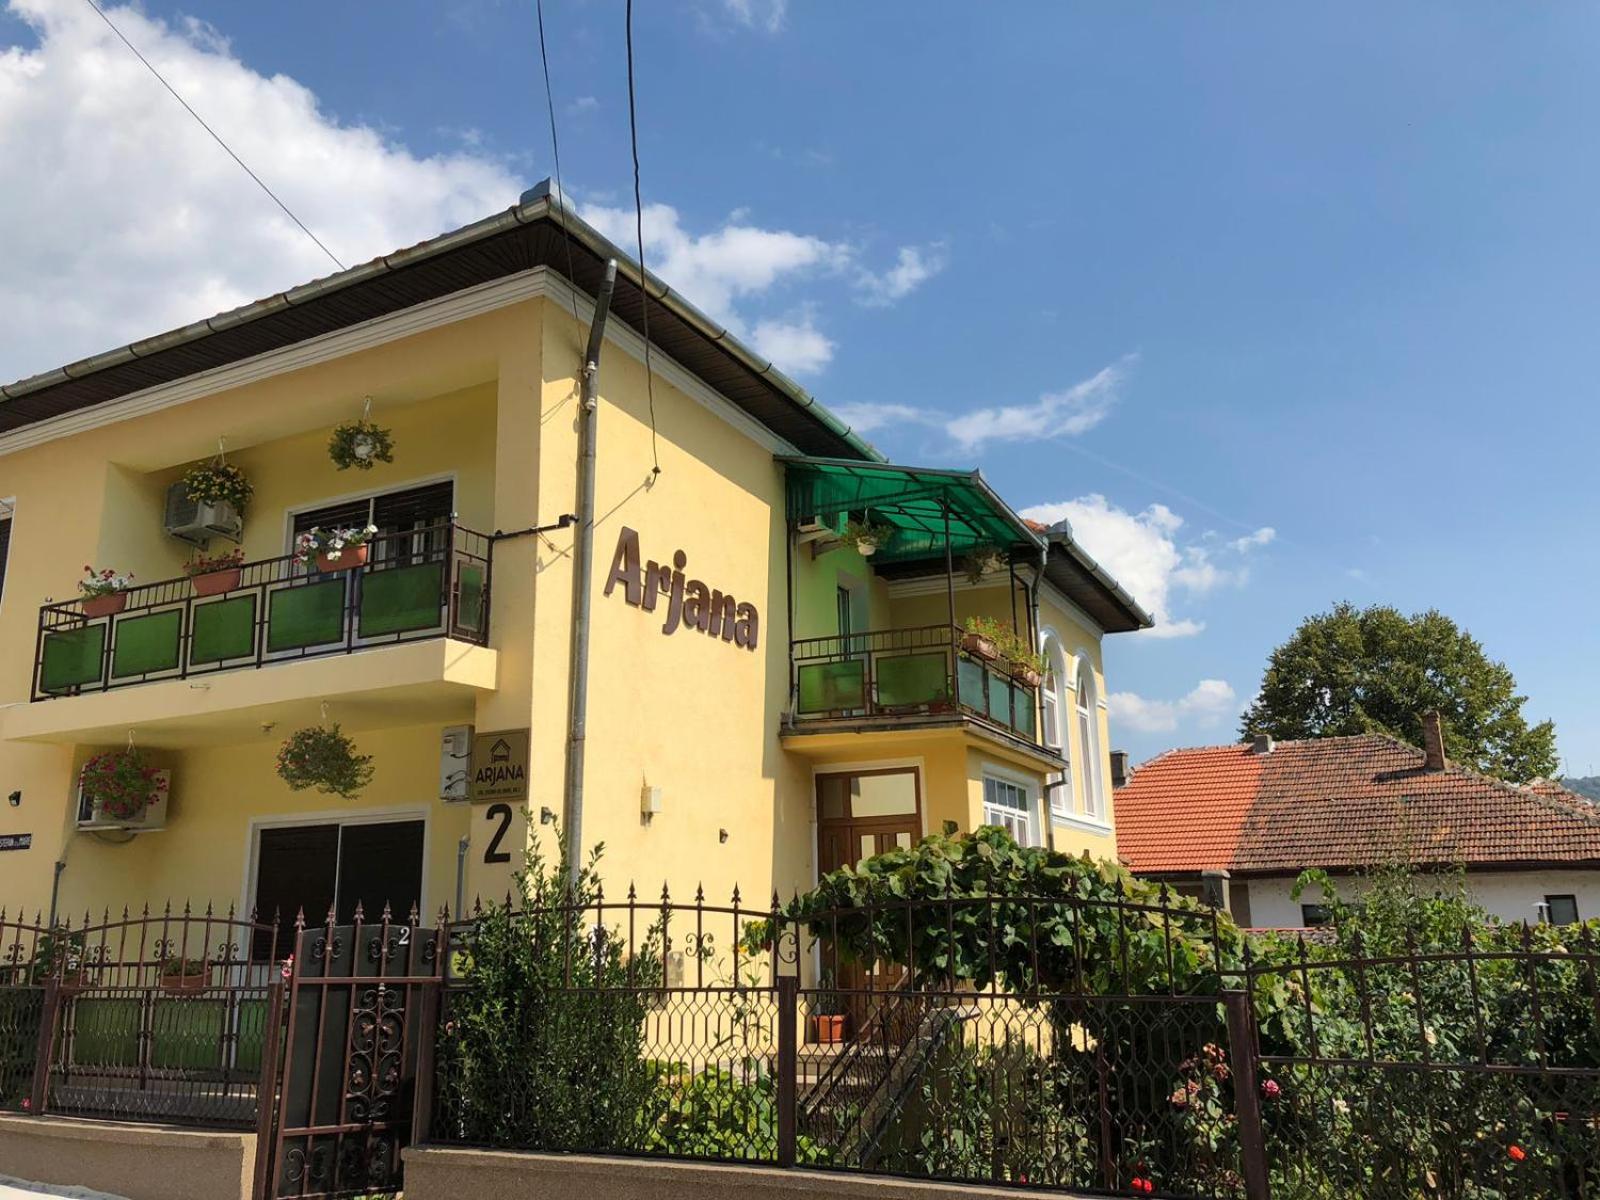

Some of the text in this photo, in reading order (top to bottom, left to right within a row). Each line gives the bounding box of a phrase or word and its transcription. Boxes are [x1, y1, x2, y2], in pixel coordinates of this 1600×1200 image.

[603, 526, 759, 651] Arjana
[475, 764, 525, 786] ARJANA
[484, 803, 513, 864] 2
[398, 927, 411, 945] 2
